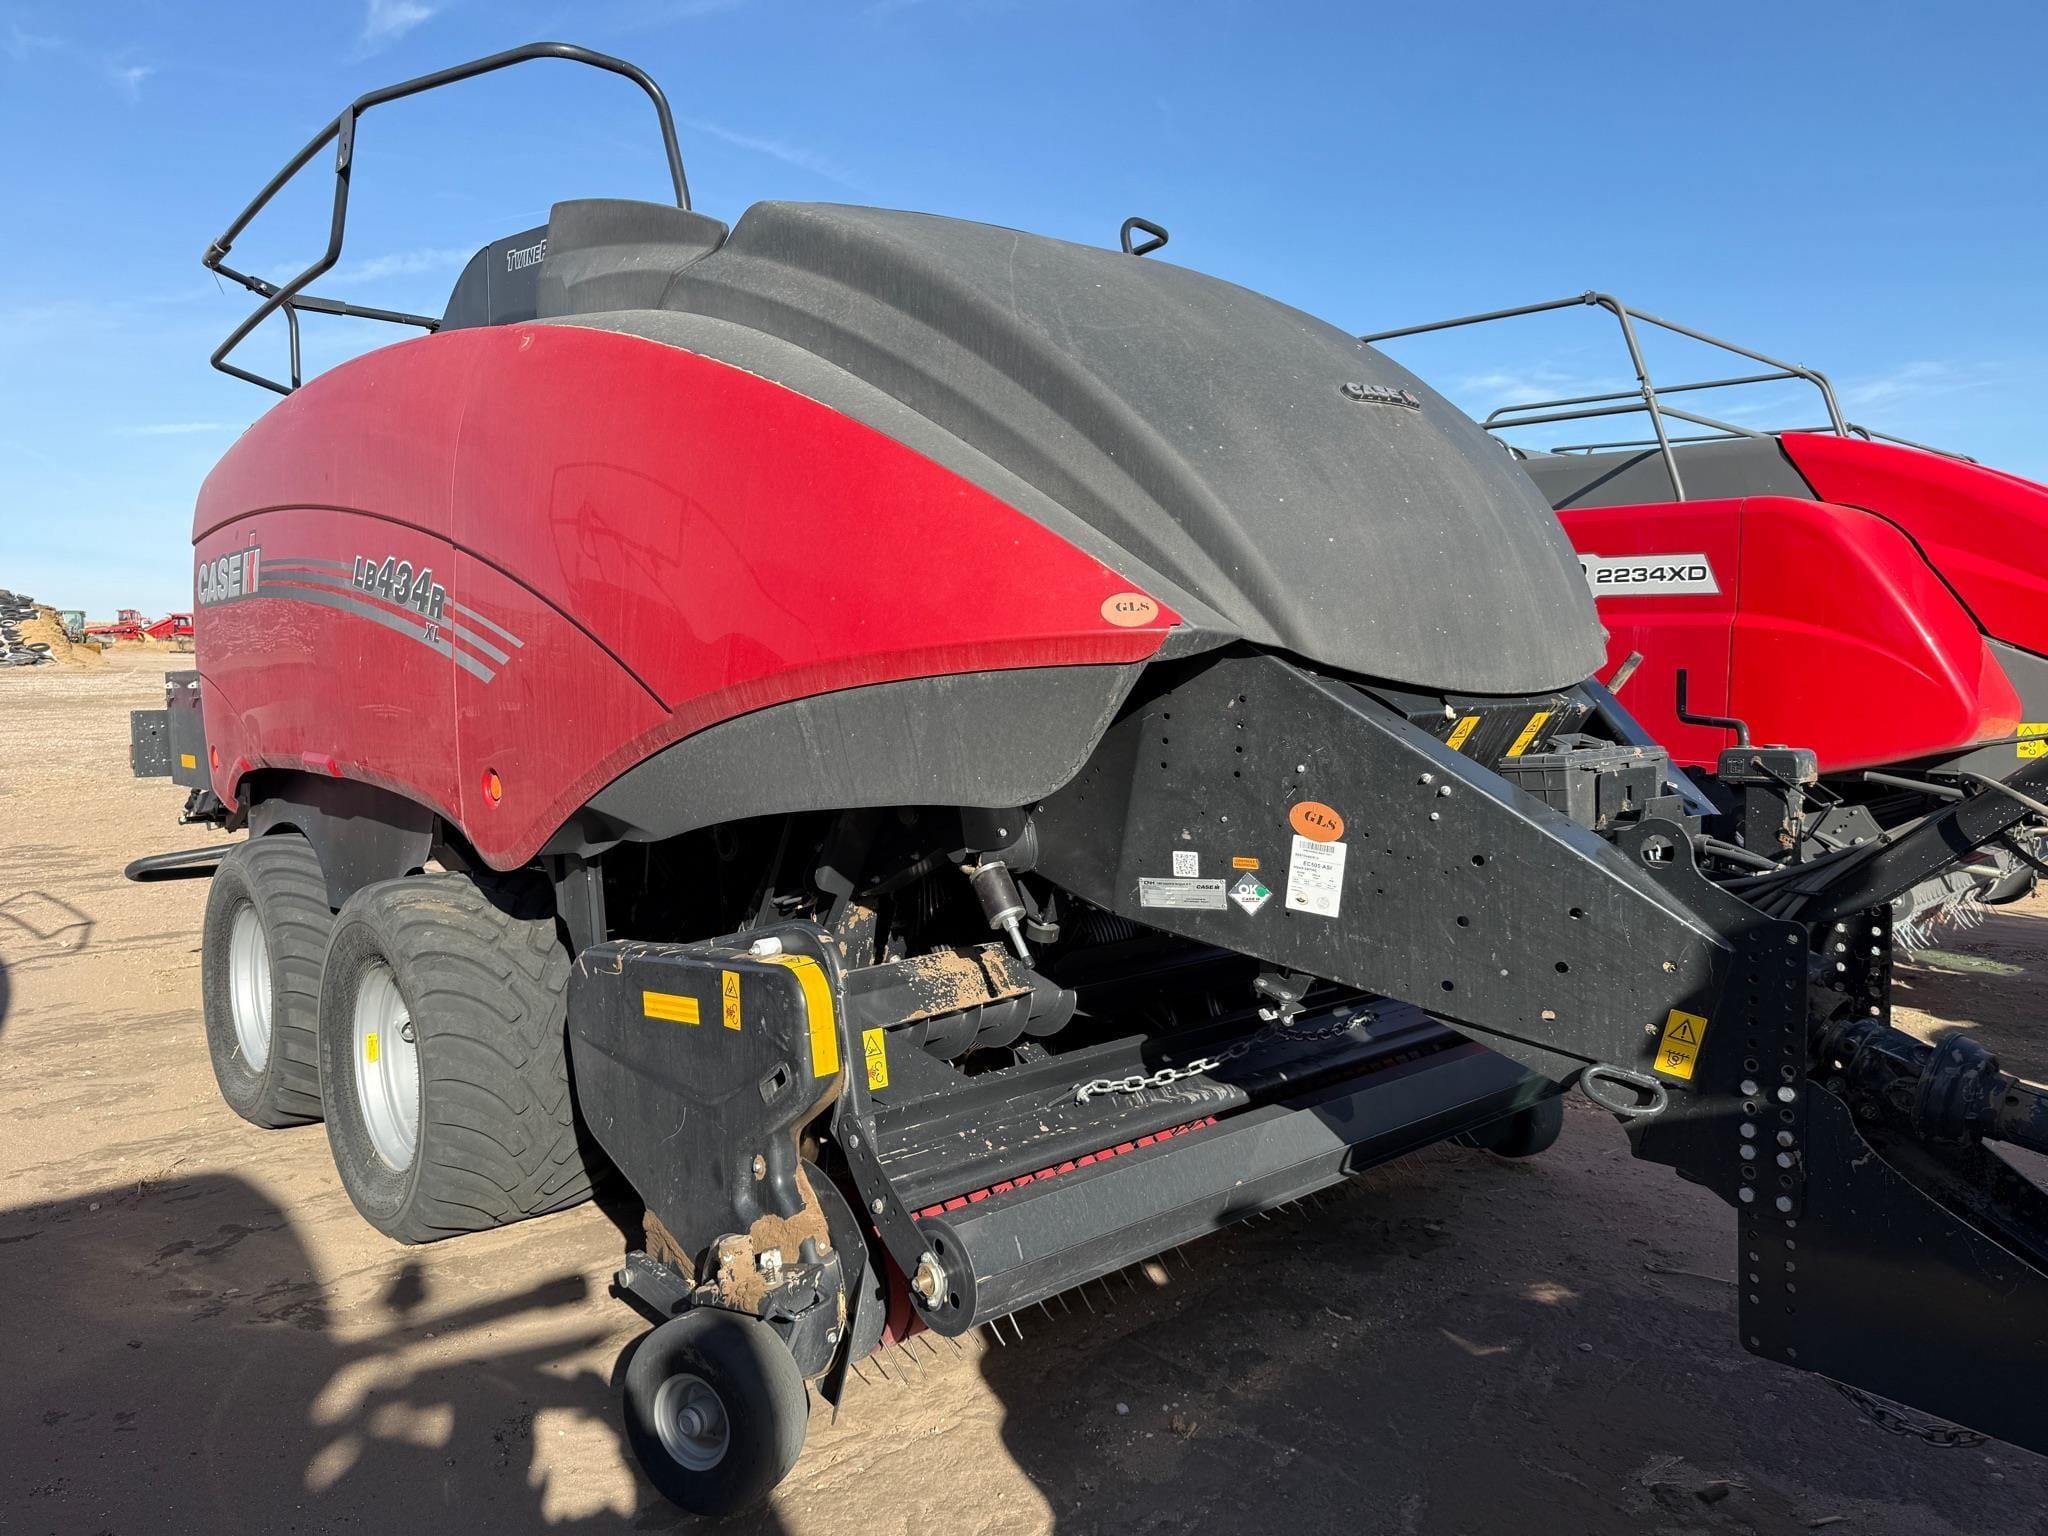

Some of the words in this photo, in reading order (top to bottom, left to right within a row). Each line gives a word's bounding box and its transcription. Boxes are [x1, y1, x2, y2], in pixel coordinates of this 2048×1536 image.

[1596, 566, 1706, 583] 2234XD
[1115, 602, 1150, 612] GLS
[423, 622, 440, 644] XL
[1304, 810, 1337, 831] GLS
